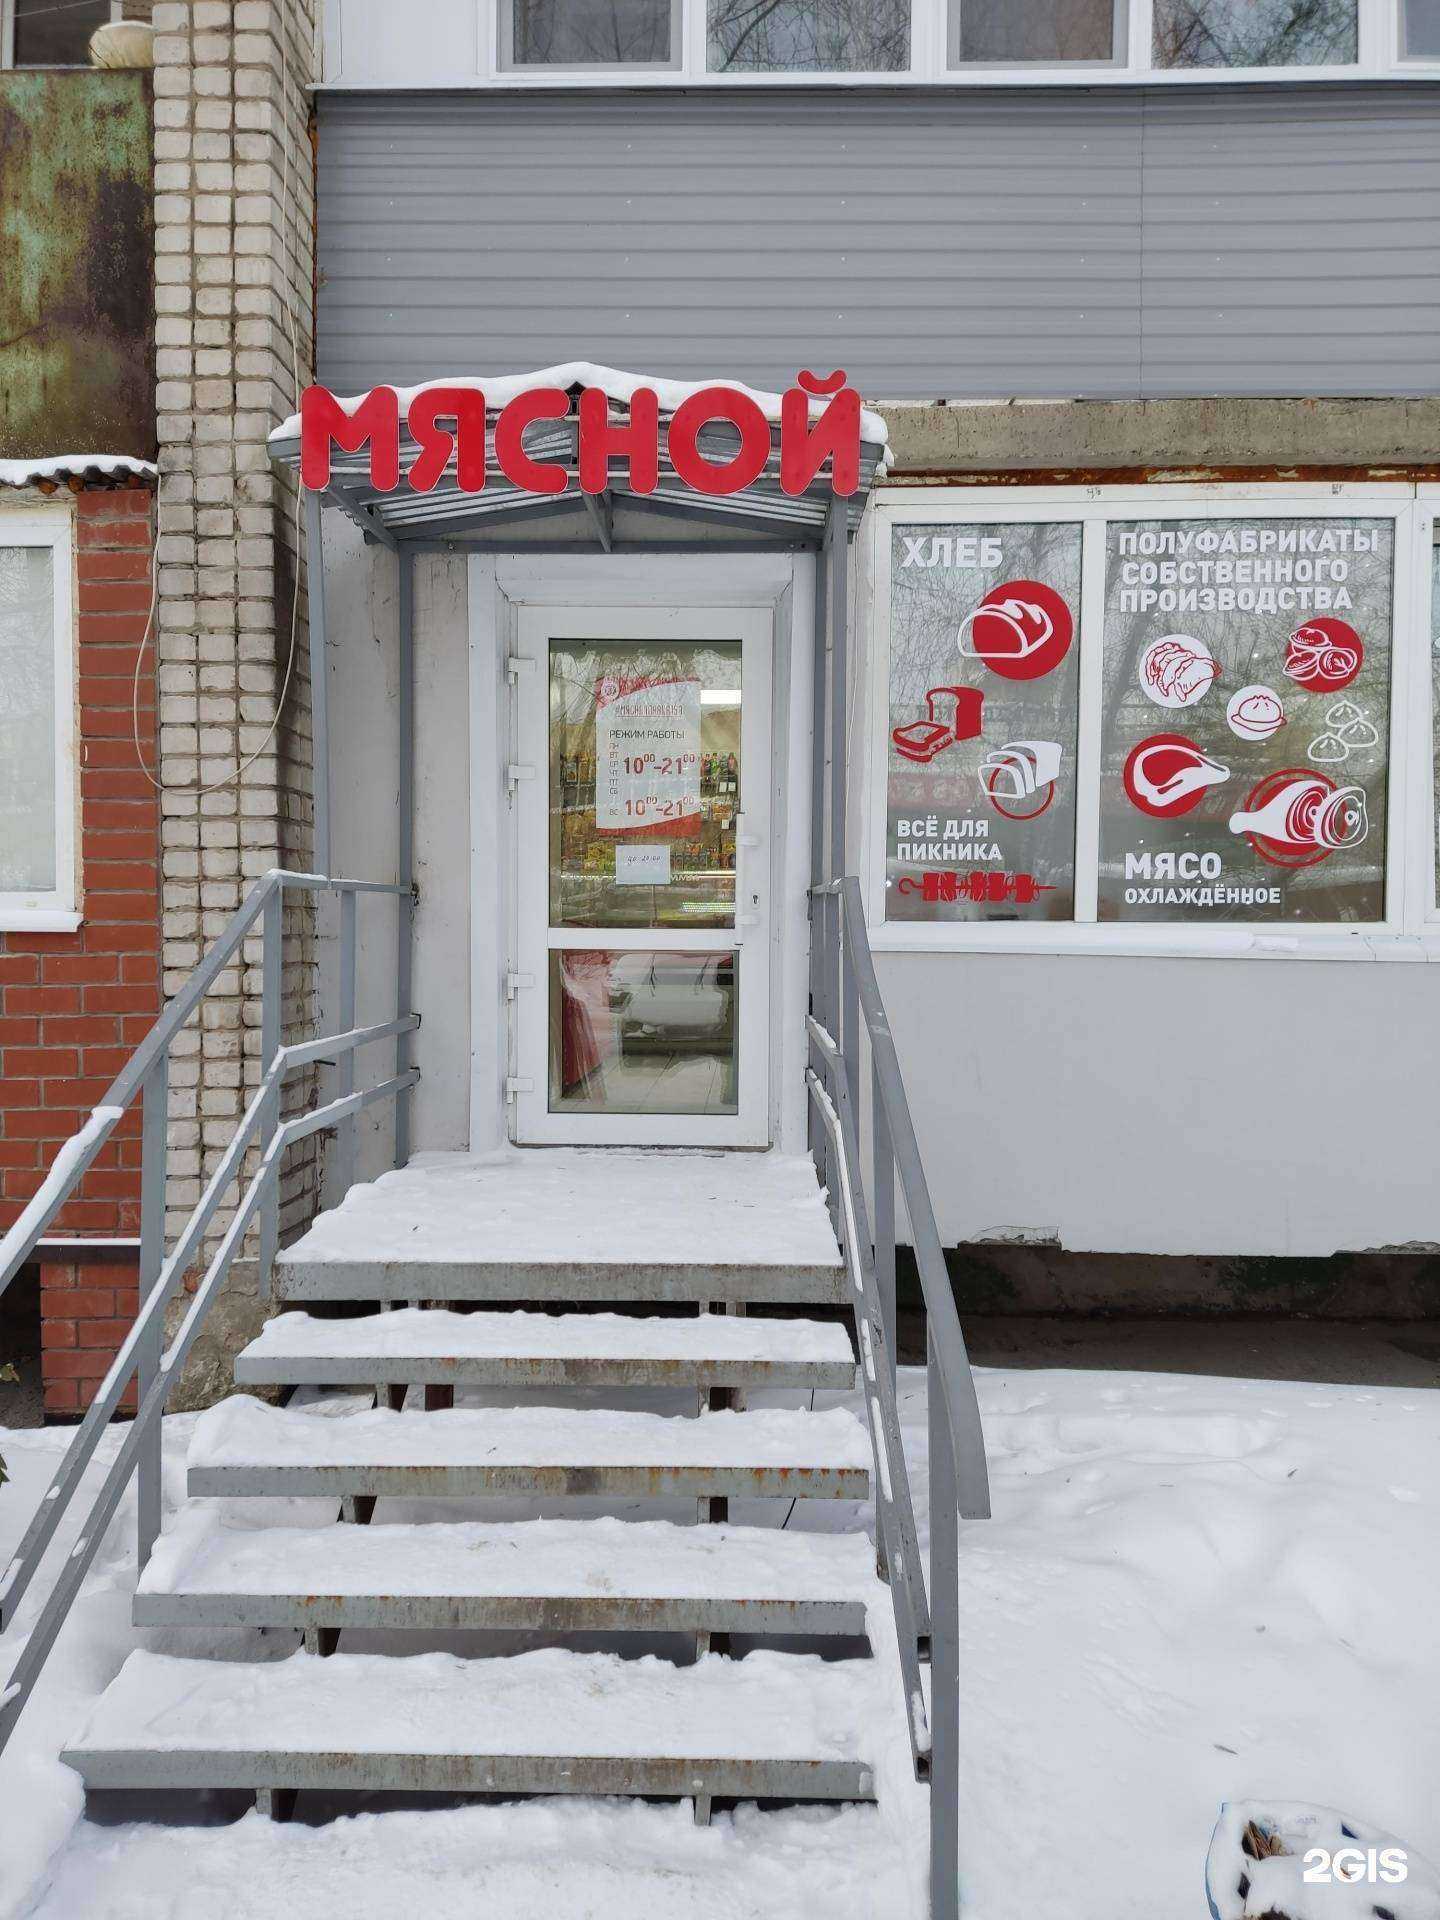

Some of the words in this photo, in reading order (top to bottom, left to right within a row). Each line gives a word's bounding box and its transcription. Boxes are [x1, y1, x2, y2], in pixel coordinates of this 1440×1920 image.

[301, 369, 861, 496] МЯСНОЙ
[901, 537, 1003, 568] ХЛЕБ
[1119, 529, 1379, 555] ПОЛУФАБРИКАТЫ
[1122, 559, 1349, 584] СОБСТВЕННОГО
[1119, 586, 1353, 614] ПРОИЗВОДСТВА
[609, 730, 645, 739] РЕЖИМ
[647, 730, 685, 739] РАБОТЫ
[897, 815, 938, 837] ВСЁ
[943, 819, 989, 840] ДЛЯ
[897, 843, 1003, 861] ПИКНИКА
[1125, 852, 1222, 880] МЯСО
[1124, 884, 1281, 907] ОХЛАЖДЁННОЕ
